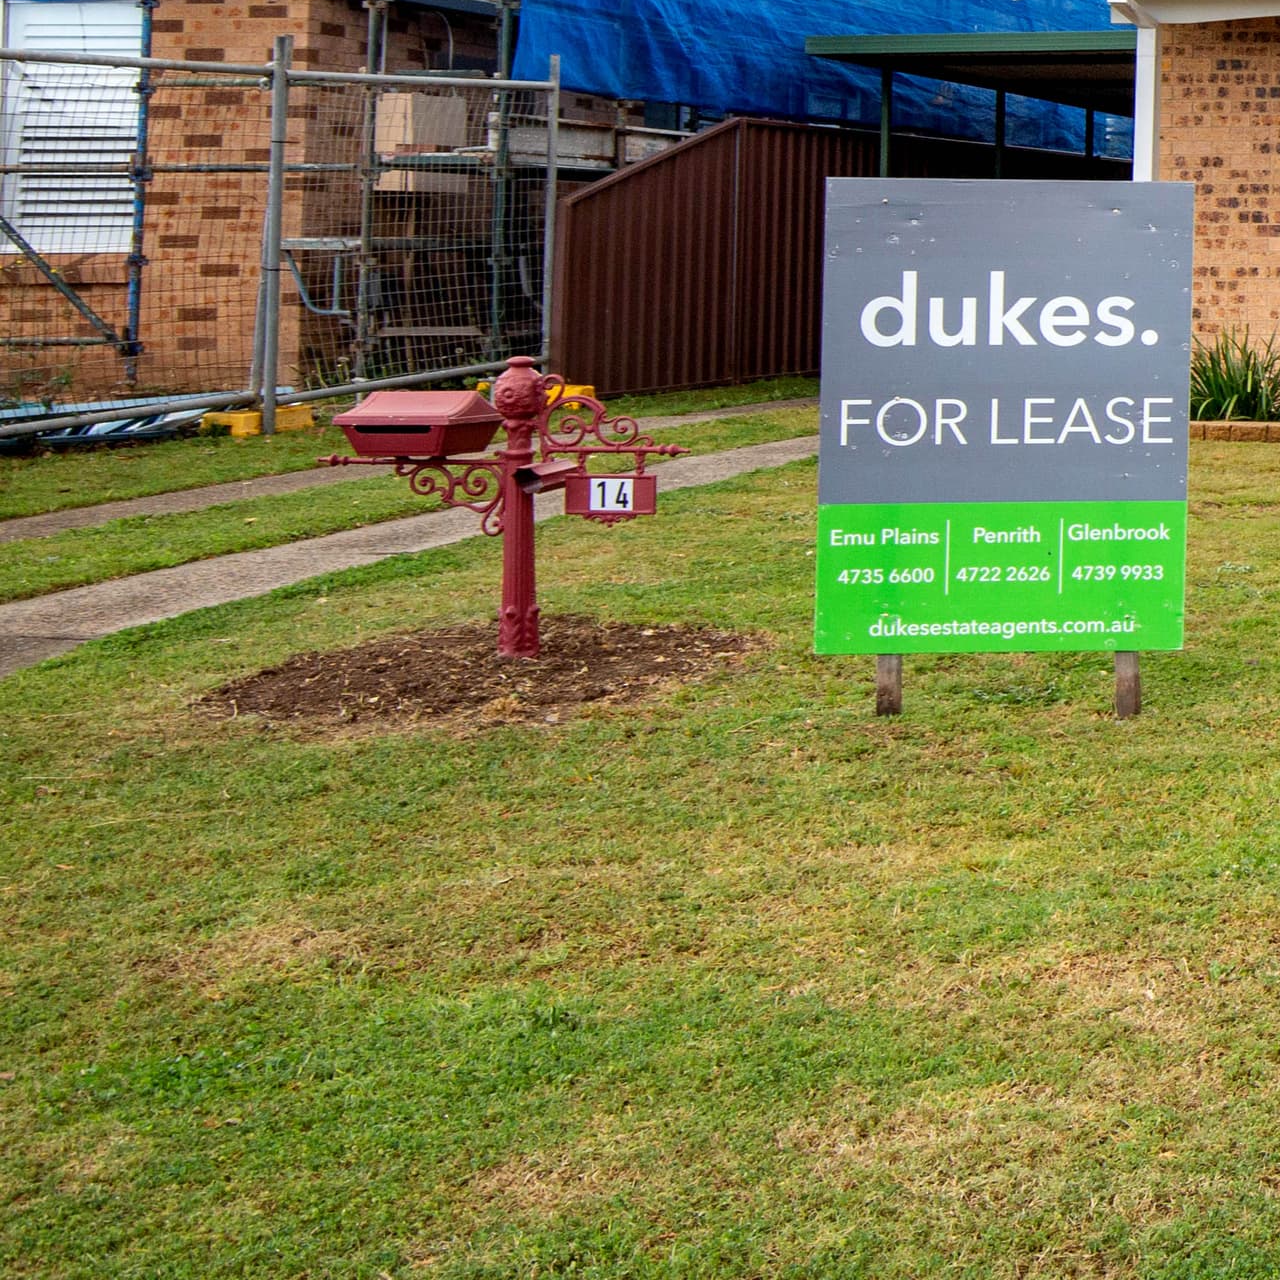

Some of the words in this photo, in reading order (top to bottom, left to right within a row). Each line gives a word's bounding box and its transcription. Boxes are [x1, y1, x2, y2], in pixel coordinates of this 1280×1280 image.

[860, 270, 1159, 347] dukes.
[840, 397, 968, 447] FOR
[990, 397, 1174, 445] LEASE
[597, 481, 629, 508] 14
[830, 530, 875, 546] Emu
[881, 527, 940, 545] Plains
[973, 526, 1041, 544] Penrith
[1067, 523, 1171, 542] Glenbrook
[837, 568, 884, 584] 4735
[888, 567, 935, 584] 6600
[955, 566, 1001, 582] 4722
[1005, 566, 1051, 582] 2626
[1071, 565, 1117, 581] 4739
[1120, 564, 1164, 581] 9933
[868, 617, 1135, 640] dukesestateagents.com.au
